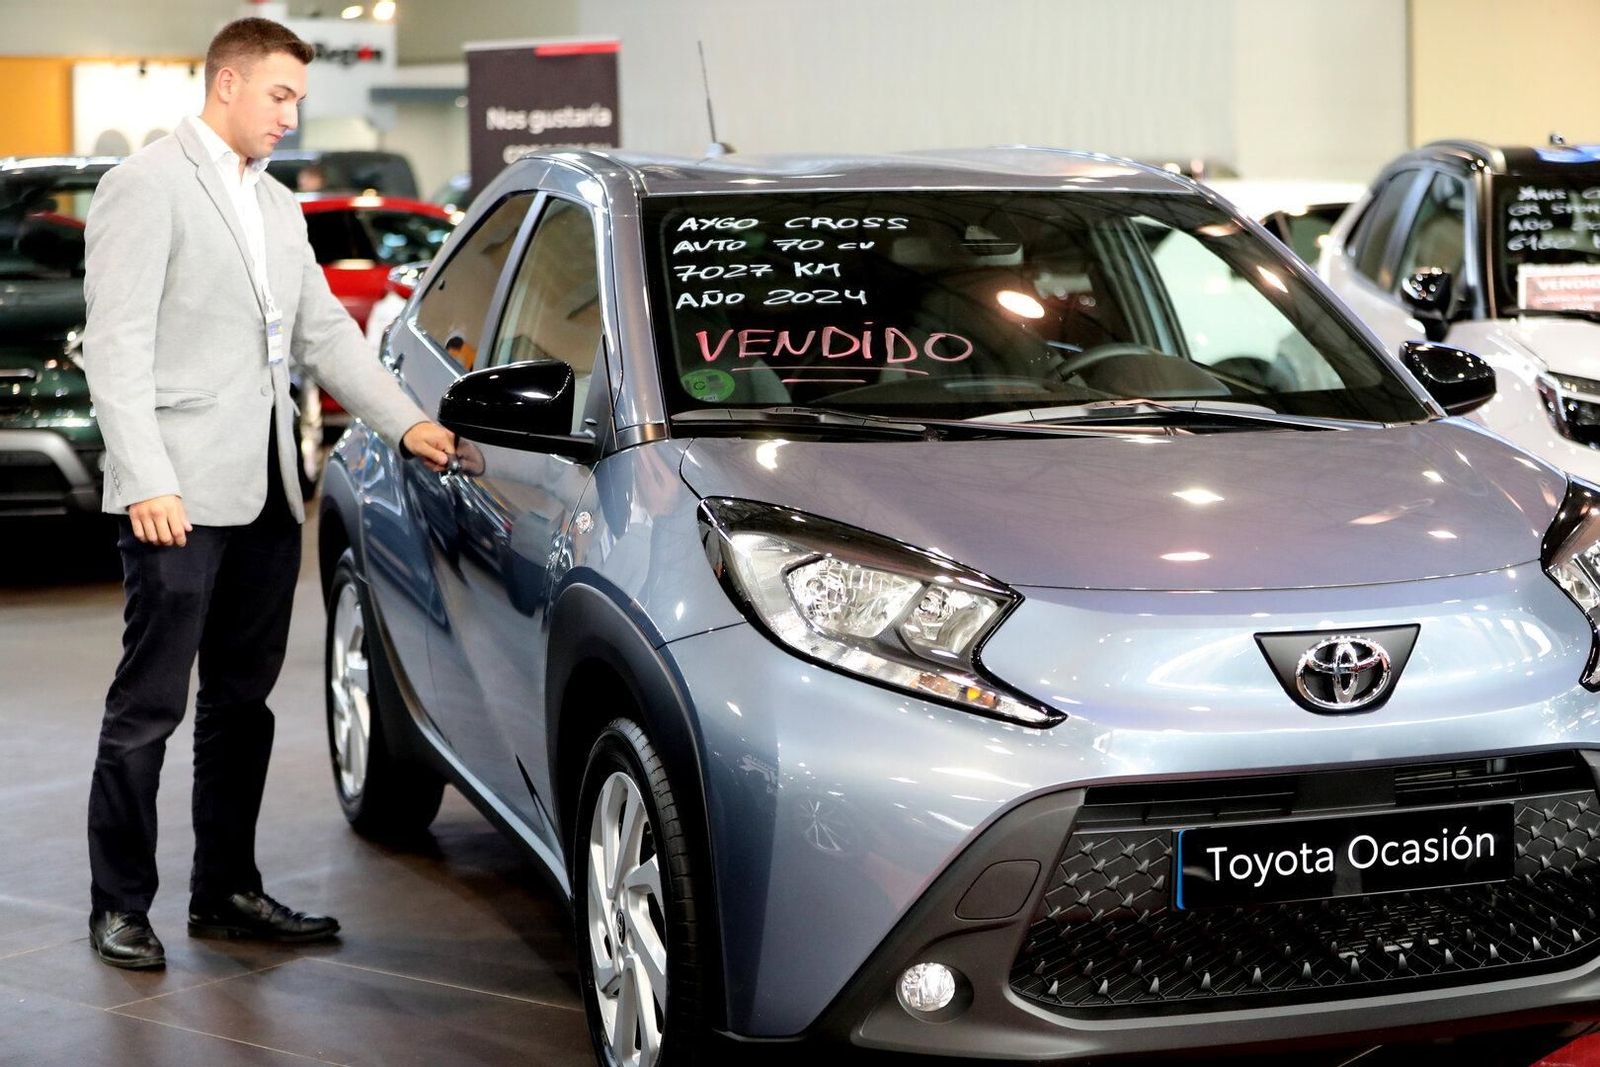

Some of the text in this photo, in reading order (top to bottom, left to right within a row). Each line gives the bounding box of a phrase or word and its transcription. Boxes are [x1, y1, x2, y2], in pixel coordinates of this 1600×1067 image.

[486, 103, 613, 134] Nos gustaría
[677, 217, 909, 232] AYGO CROSS
[673, 239, 747, 254] AUTO
[772, 239, 825, 251] 70
[673, 261, 841, 281] 7027 KM
[675, 289, 868, 310] AÑO 2024
[1206, 826, 1495, 887] Toyota Ocasión
